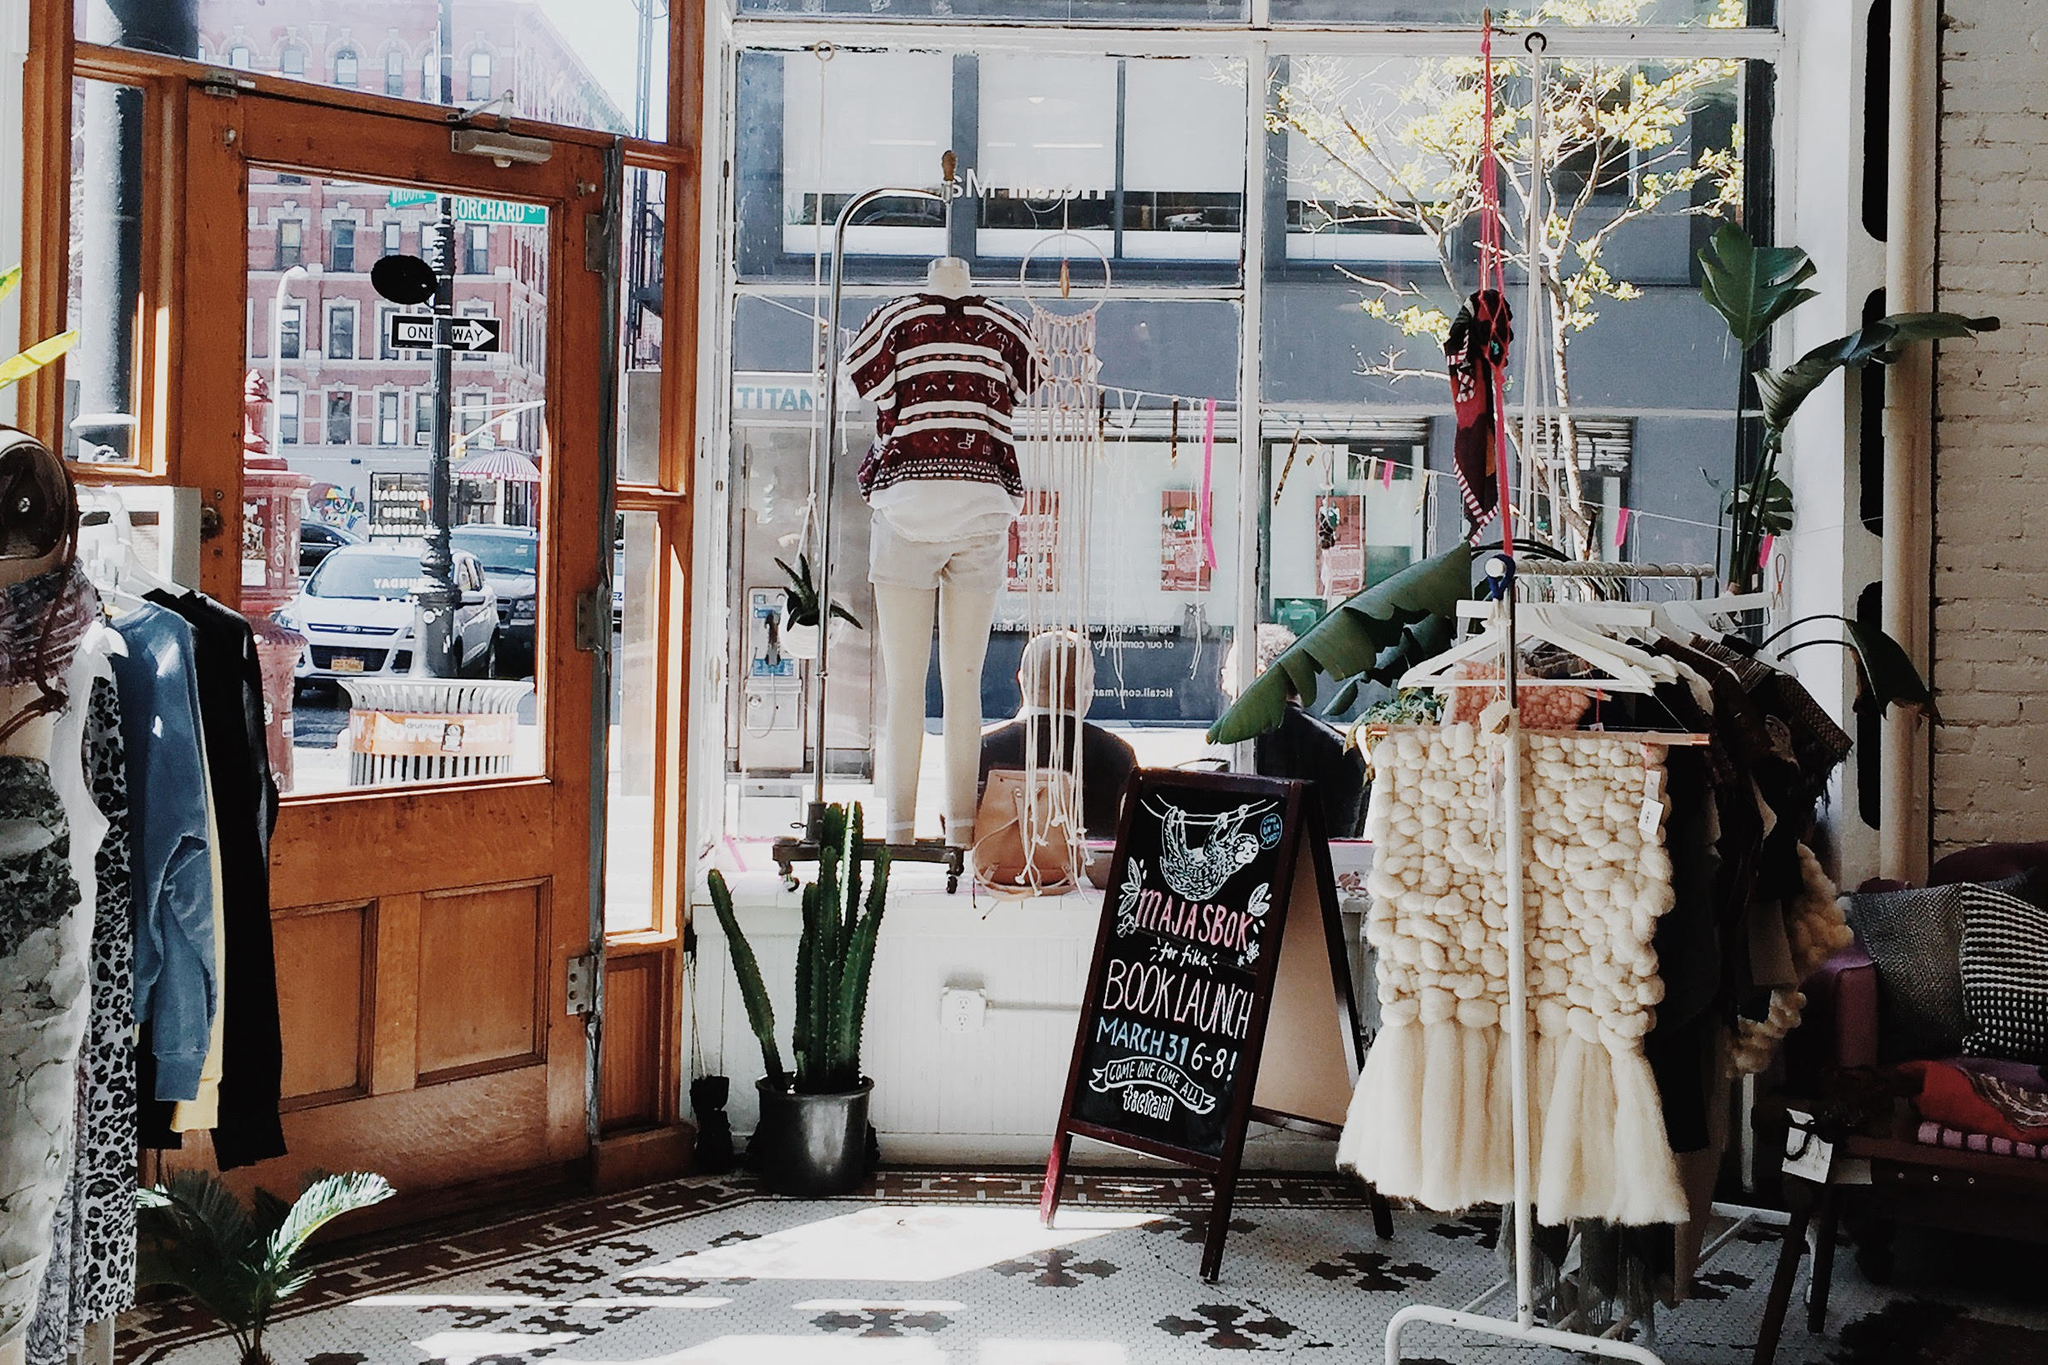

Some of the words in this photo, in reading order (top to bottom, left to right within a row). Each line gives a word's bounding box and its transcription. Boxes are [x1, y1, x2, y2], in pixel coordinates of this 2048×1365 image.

[457, 199, 525, 223] ORCHARD
[452, 328, 484, 342] WAY
[737, 387, 819, 411] TITAN
[1135, 888, 1254, 951] MAJASBOK
[1158, 941, 1178, 962] for
[1103, 958, 1176, 1019] BOOK
[1173, 973, 1254, 1039] LAUNCH
[1096, 1016, 1165, 1057] MARCH
[1165, 1033, 1190, 1066] 31
[1109, 1061, 1136, 1081] COME
[1136, 1060, 1157, 1079] ONE
[1156, 1064, 1181, 1089] COME
[1179, 1081, 1199, 1105] ALL
[1122, 1084, 1175, 1122] tictail
